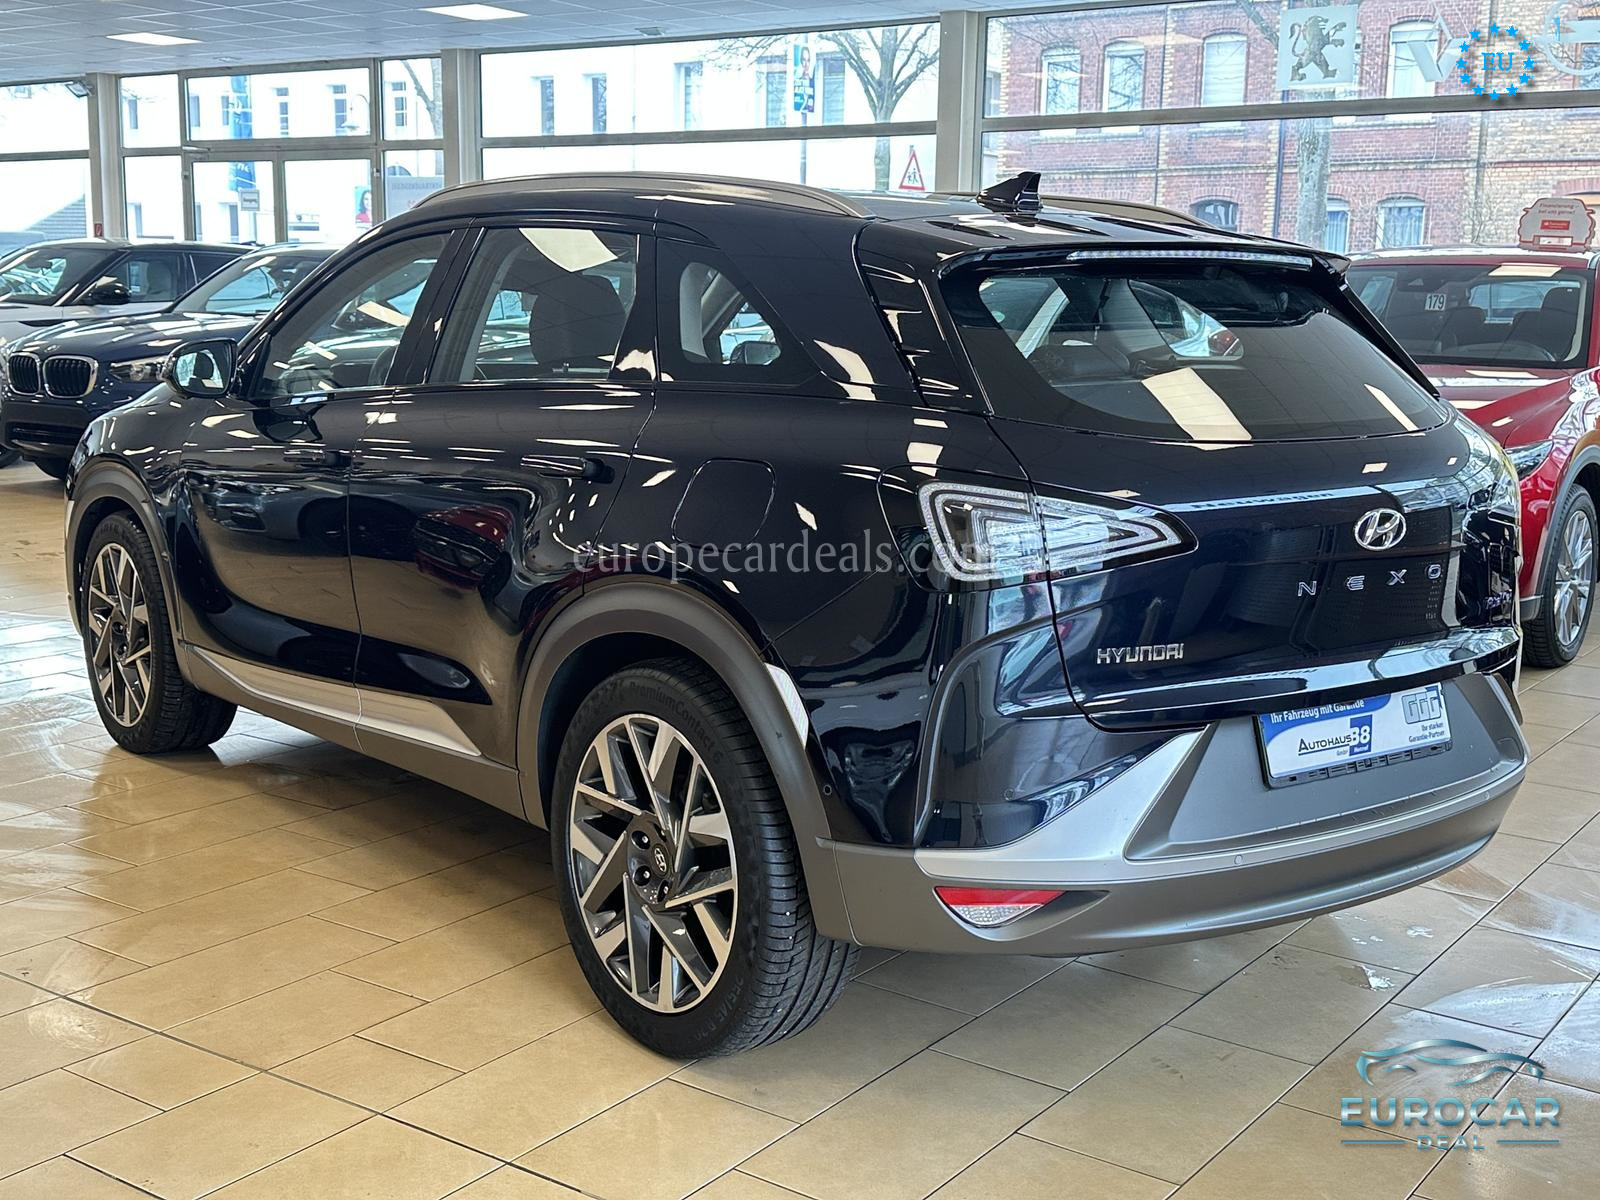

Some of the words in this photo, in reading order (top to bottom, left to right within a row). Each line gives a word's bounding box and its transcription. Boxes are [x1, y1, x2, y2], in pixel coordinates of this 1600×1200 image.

[1428, 294, 1445, 309] 179
[1096, 642, 1185, 664] HYUNDAI
[1270, 712, 1283, 724] Ihr
[1283, 707, 1319, 721] Fahrzeug
[1319, 703, 1333, 715] mit
